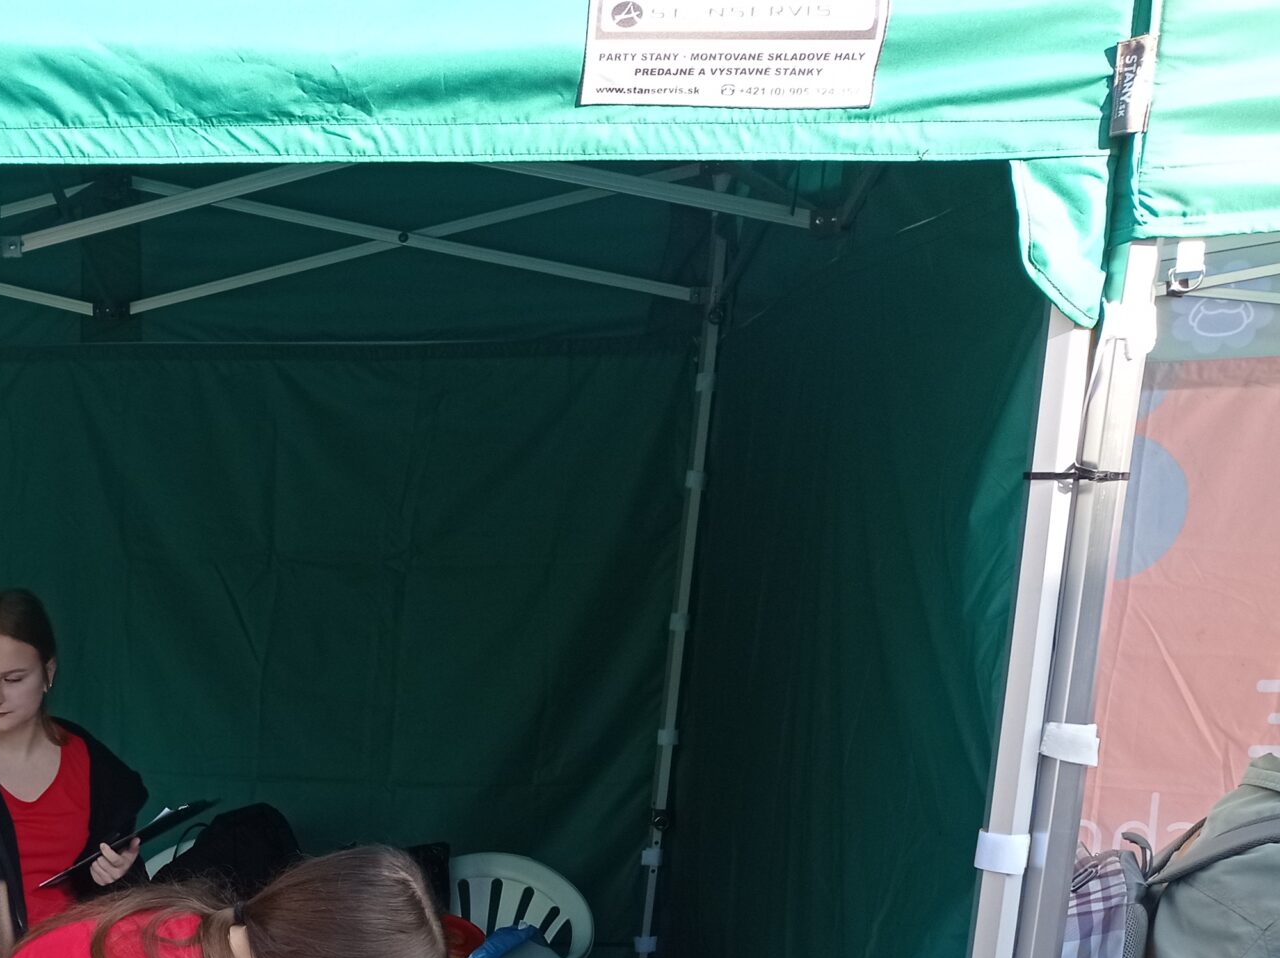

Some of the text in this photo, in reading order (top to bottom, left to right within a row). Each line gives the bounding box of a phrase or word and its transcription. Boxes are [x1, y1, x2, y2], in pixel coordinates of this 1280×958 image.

[598, 53, 637, 61] PARTY
[640, 53, 679, 61] STANY
[833, 52, 866, 61] HALY
[698, 67, 706, 75] A
[596, 86, 700, 94] www.stanservis.sk
[739, 87, 766, 95] +421
